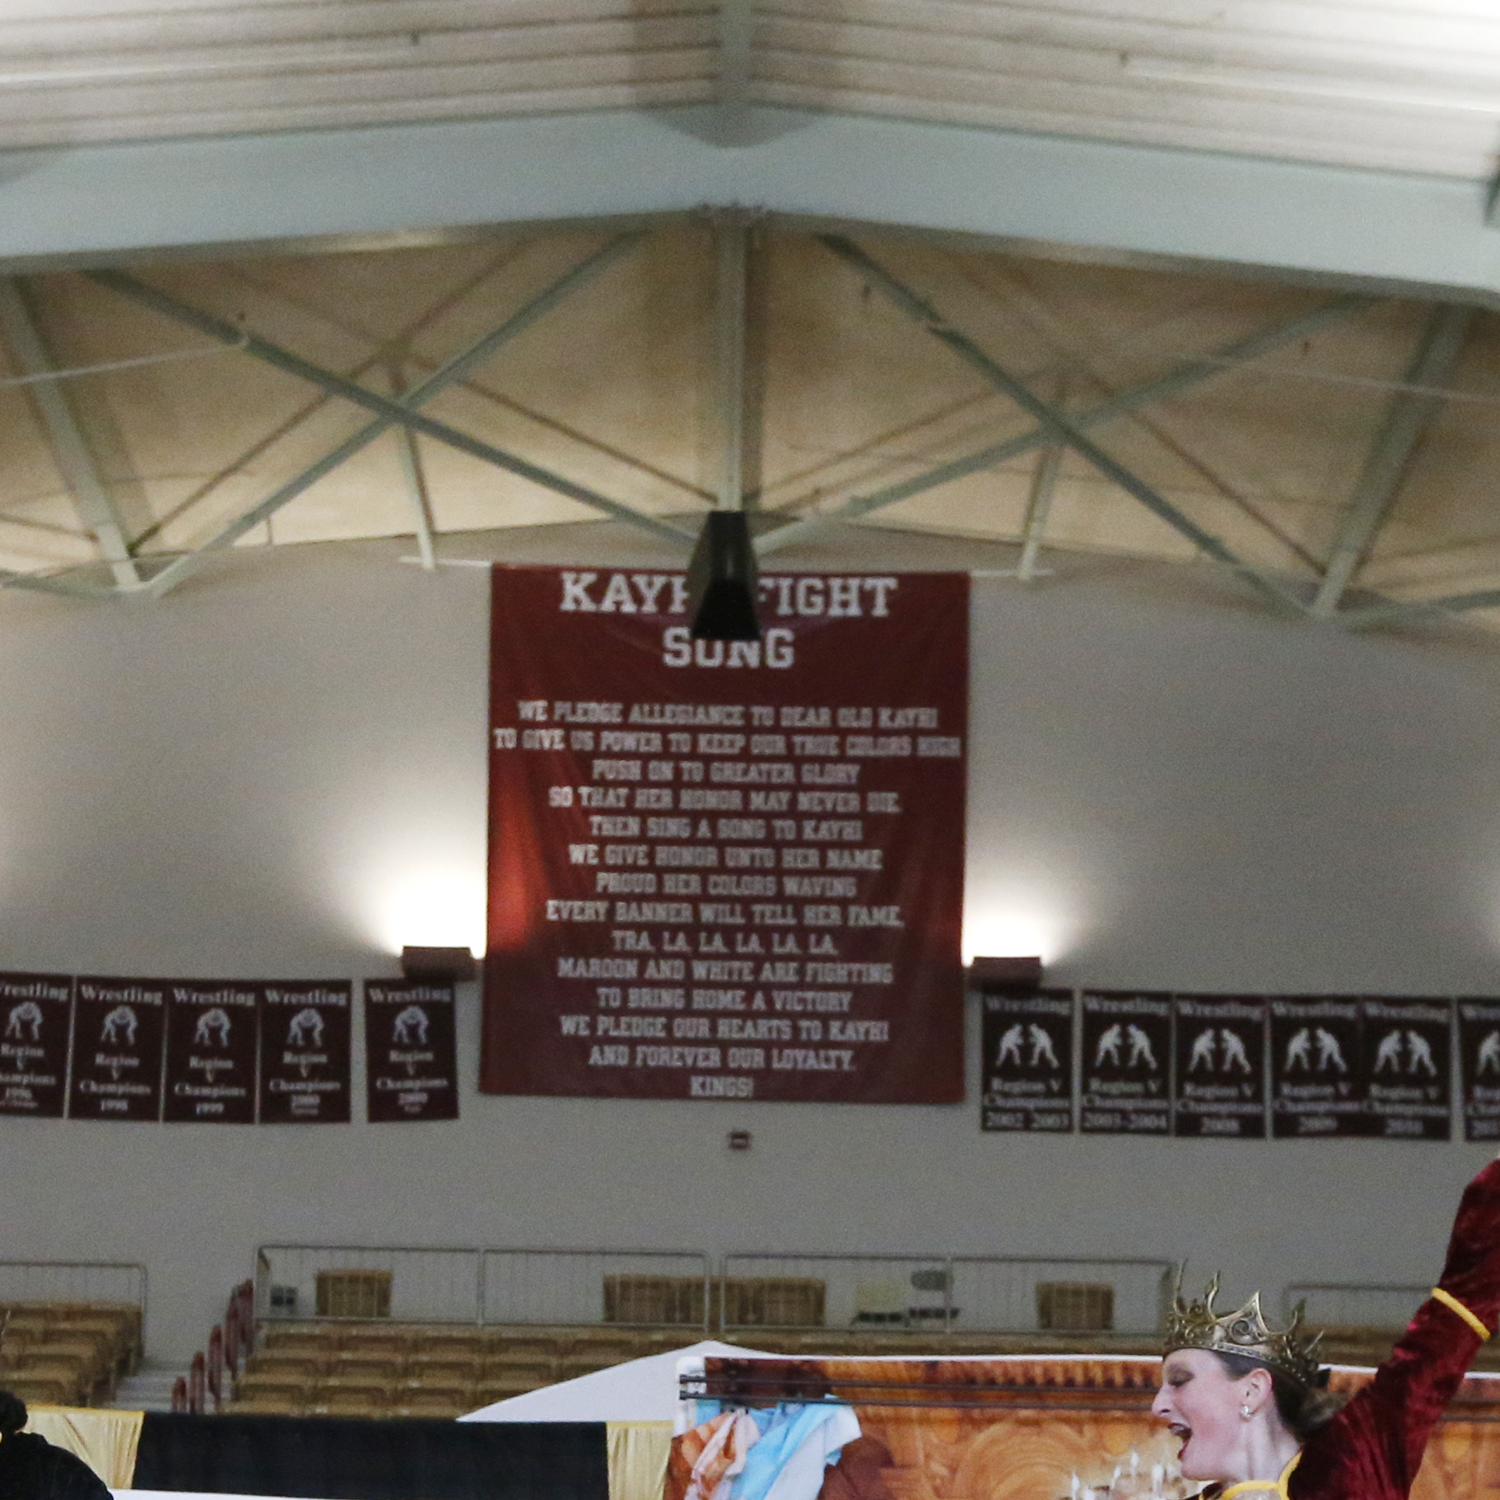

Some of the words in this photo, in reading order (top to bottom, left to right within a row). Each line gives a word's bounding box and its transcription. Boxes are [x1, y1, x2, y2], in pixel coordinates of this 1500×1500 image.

[663, 626, 794, 668] SONG
[519, 700, 547, 721] WE
[554, 702, 622, 723] PLEDGE
[629, 704, 744, 725] ALLEGIANCE
[751, 706, 774, 726] TO
[494, 728, 516, 748] TO
[524, 729, 564, 750] GIVE
[601, 731, 661, 752] POWER
[668, 733, 691, 752] TO
[593, 760, 641, 780] PUSH
[680, 761, 703, 781] TO
[711, 762, 794, 783] GREATER
[550, 786, 573, 807] SO
[578, 786, 628, 807] THAT
[750, 791, 790, 810] MAY
[798, 792, 860, 812] NEVER
[590, 815, 640, 836] THEN
[647, 817, 690, 837] SING
[697, 819, 710, 838] A
[773, 820, 796, 839] TO
[569, 844, 598, 864] WE
[605, 845, 648, 865] GIVE
[782, 849, 819, 868] HER
[827, 850, 882, 870] NAME
[596, 872, 656, 893] PROUD
[664, 874, 701, 894] HER
[708, 875, 776, 895] COLORS
[783, 877, 856, 896] WAVING
[546, 900, 608, 921] EVERY
[616, 902, 692, 922] BANNER
[700, 904, 745, 924] WILL
[752, 904, 796, 925] TELL
[804, 905, 841, 925] HER
[558, 958, 638, 978] MAROON
[645, 960, 684, 979] AND
[692, 961, 753, 981] WHITE
[760, 962, 798, 982] ARE
[806, 963, 893, 983] FIGHTING
[80, 984, 163, 1006] Wrestling
[173, 987, 255, 1007] Wrestling
[264, 988, 348, 1007] Wrestling
[368, 987, 451, 1003] Wrestling
[597, 987, 621, 1007] TO
[628, 988, 684, 1008] BRING
[693, 990, 745, 1010] HOME
[752, 991, 765, 1010] A
[773, 991, 852, 1011] VICTORY
[561, 1016, 589, 1036] WE
[597, 1017, 666, 1037] PLEDGE
[673, 1018, 710, 1038] OUR
[717, 1019, 791, 1039] HEARTS
[798, 1020, 822, 1040] TO
[589, 1045, 629, 1065] AND
[636, 1046, 720, 1067] FOREVER
[728, 1048, 764, 1068] OUR
[79, 1080, 152, 1097] Champions
[174, 1082, 246, 1098] Champions
[269, 1079, 341, 1095] Champions
[376, 1076, 449, 1092] Champions
